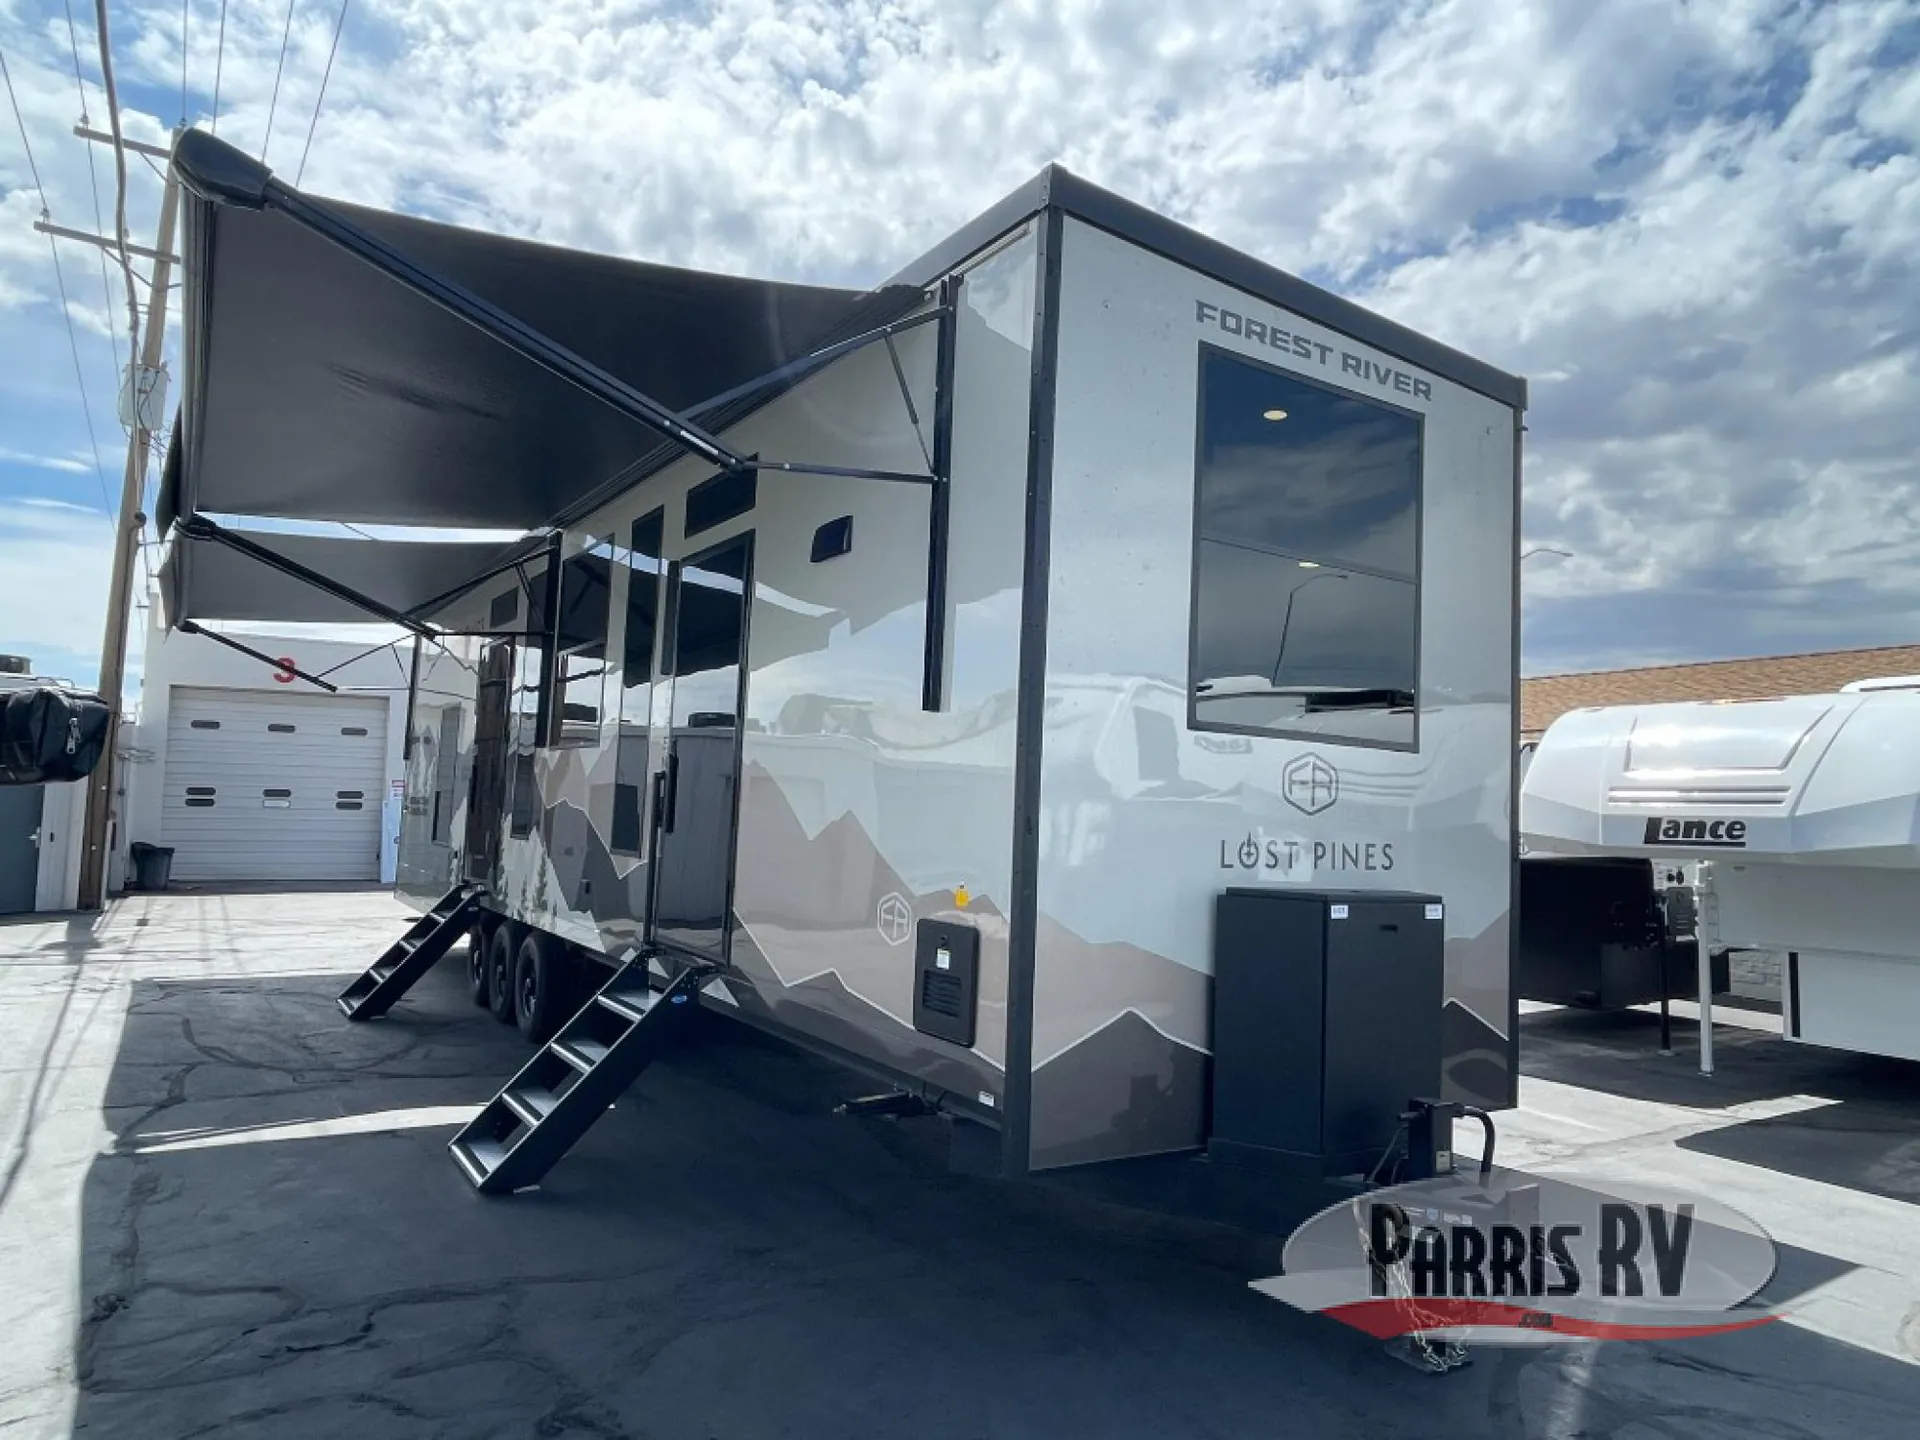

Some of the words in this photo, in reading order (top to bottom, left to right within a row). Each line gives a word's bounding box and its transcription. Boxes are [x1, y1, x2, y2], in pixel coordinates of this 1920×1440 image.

[1196, 299, 1334, 365] FOREST
[1341, 352, 1432, 402] RIVER
[273, 657, 296, 684] 3
[1643, 816, 1747, 848] Lance
[1220, 832, 1299, 869] LOST
[1313, 841, 1394, 871] PINES
